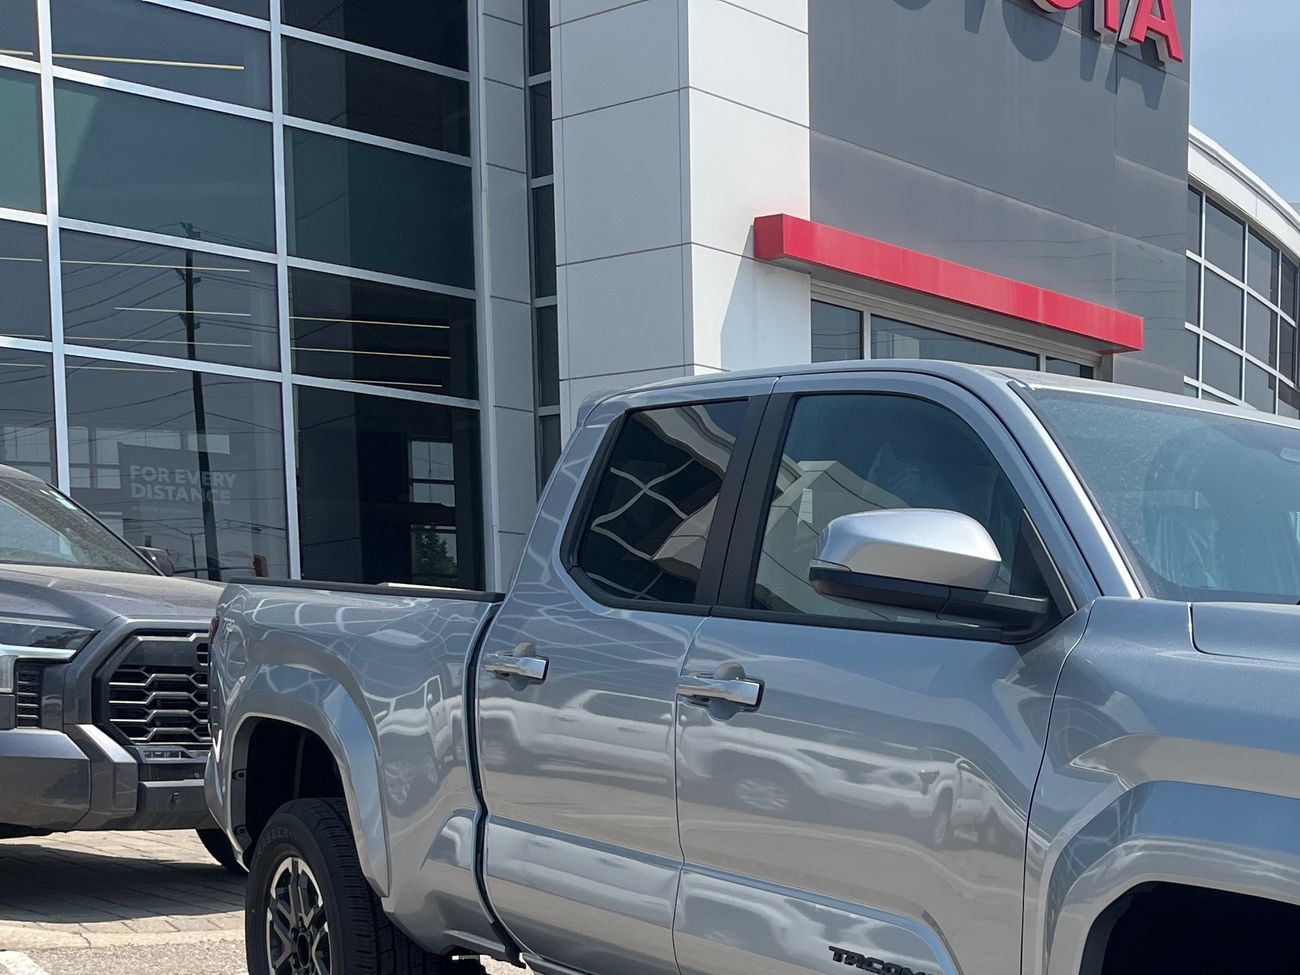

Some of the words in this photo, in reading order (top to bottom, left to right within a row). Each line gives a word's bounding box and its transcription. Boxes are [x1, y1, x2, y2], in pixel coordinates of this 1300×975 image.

[130, 464, 170, 482] FOR
[175, 468, 237, 488] EVERY
[130, 482, 231, 505] DISTANCE
